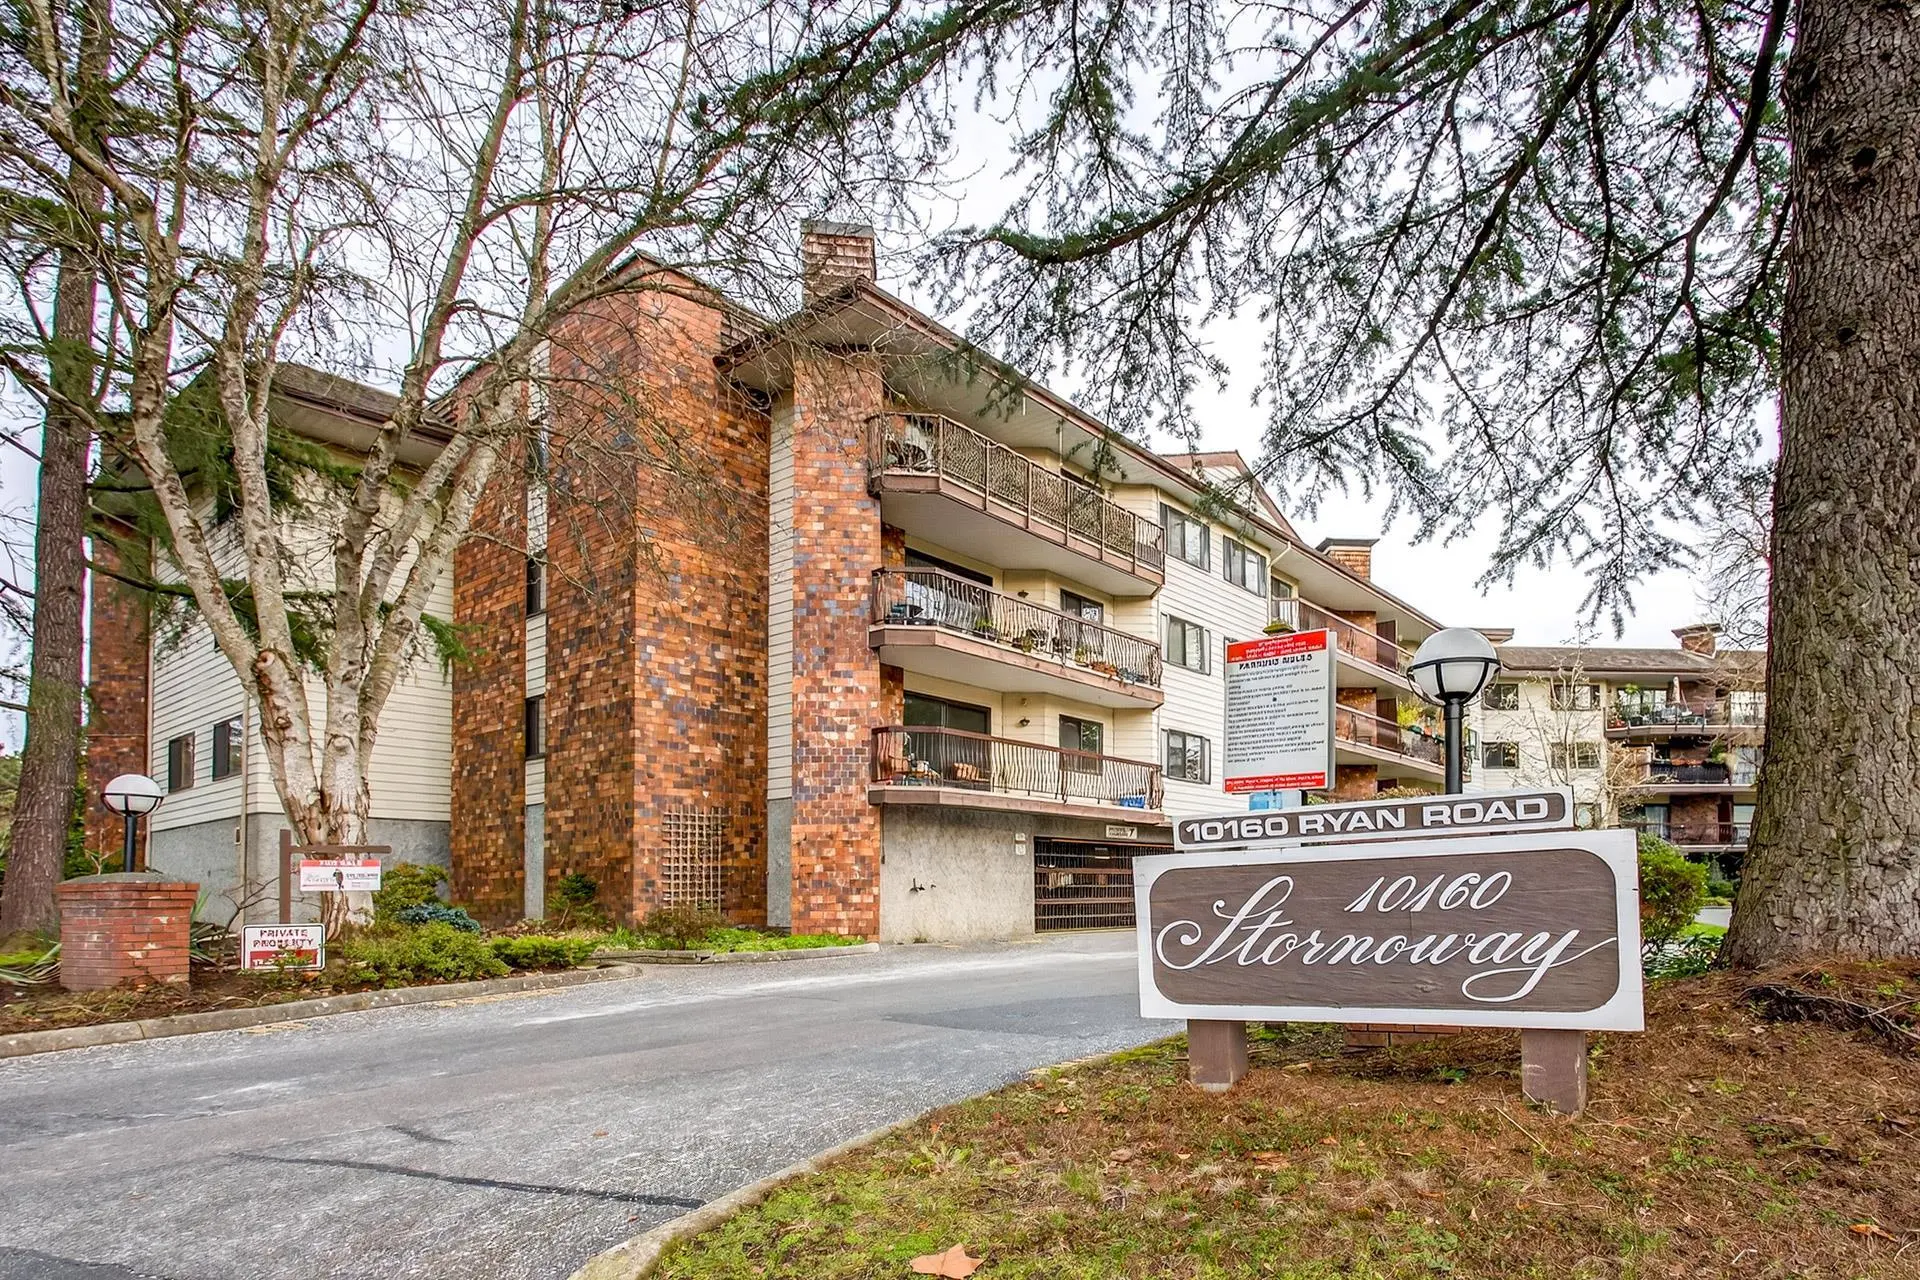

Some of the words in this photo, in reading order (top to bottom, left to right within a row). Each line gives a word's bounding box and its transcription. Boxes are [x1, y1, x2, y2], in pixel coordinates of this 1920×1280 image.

[1185, 816, 1290, 842] 10160
[1299, 807, 1404, 835] RYAN
[1422, 797, 1549, 827] ROAD
[1344, 871, 1512, 913] 10160
[260, 929, 308, 938] PRIVATE
[1155, 875, 1617, 1003] Stornoway
